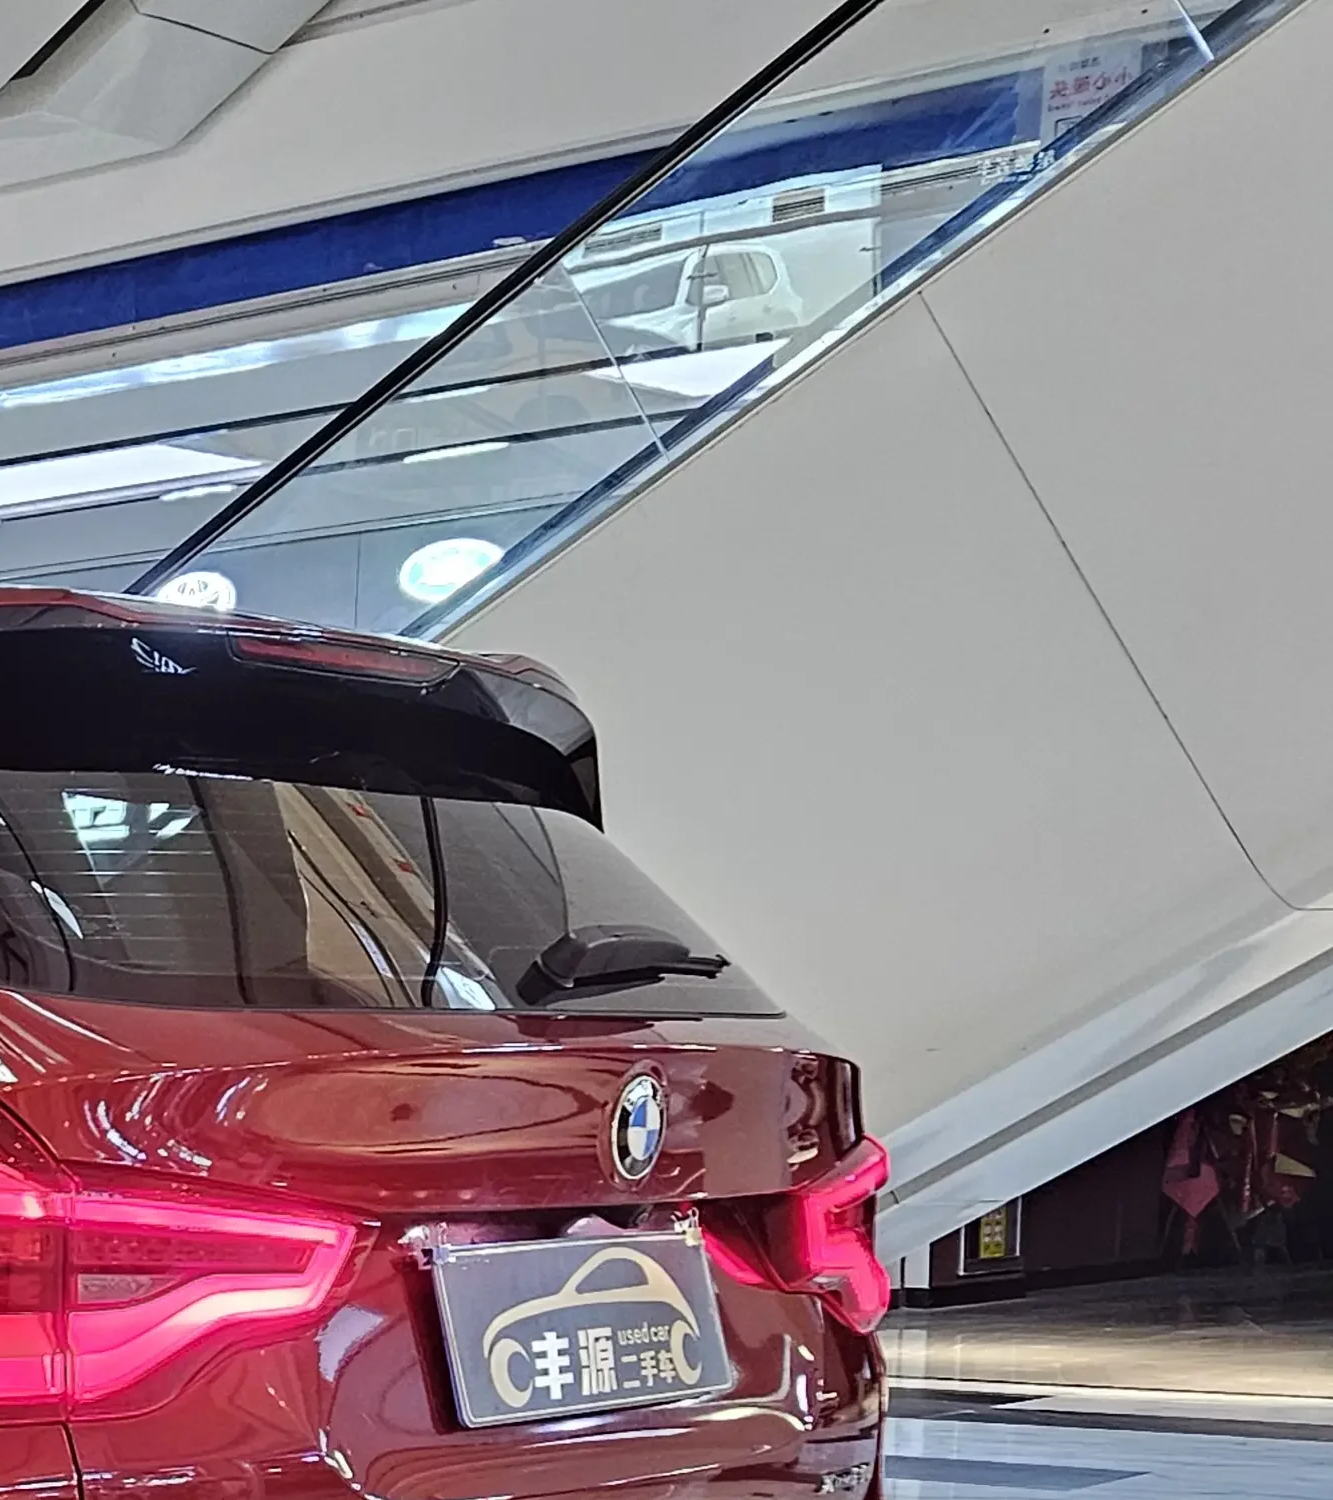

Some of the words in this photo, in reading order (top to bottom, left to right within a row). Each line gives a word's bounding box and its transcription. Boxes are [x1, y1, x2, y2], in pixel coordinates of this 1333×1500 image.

[617, 1321, 649, 1346] used
[651, 1324, 671, 1342] car
[620, 1349, 677, 1388] 二手车
